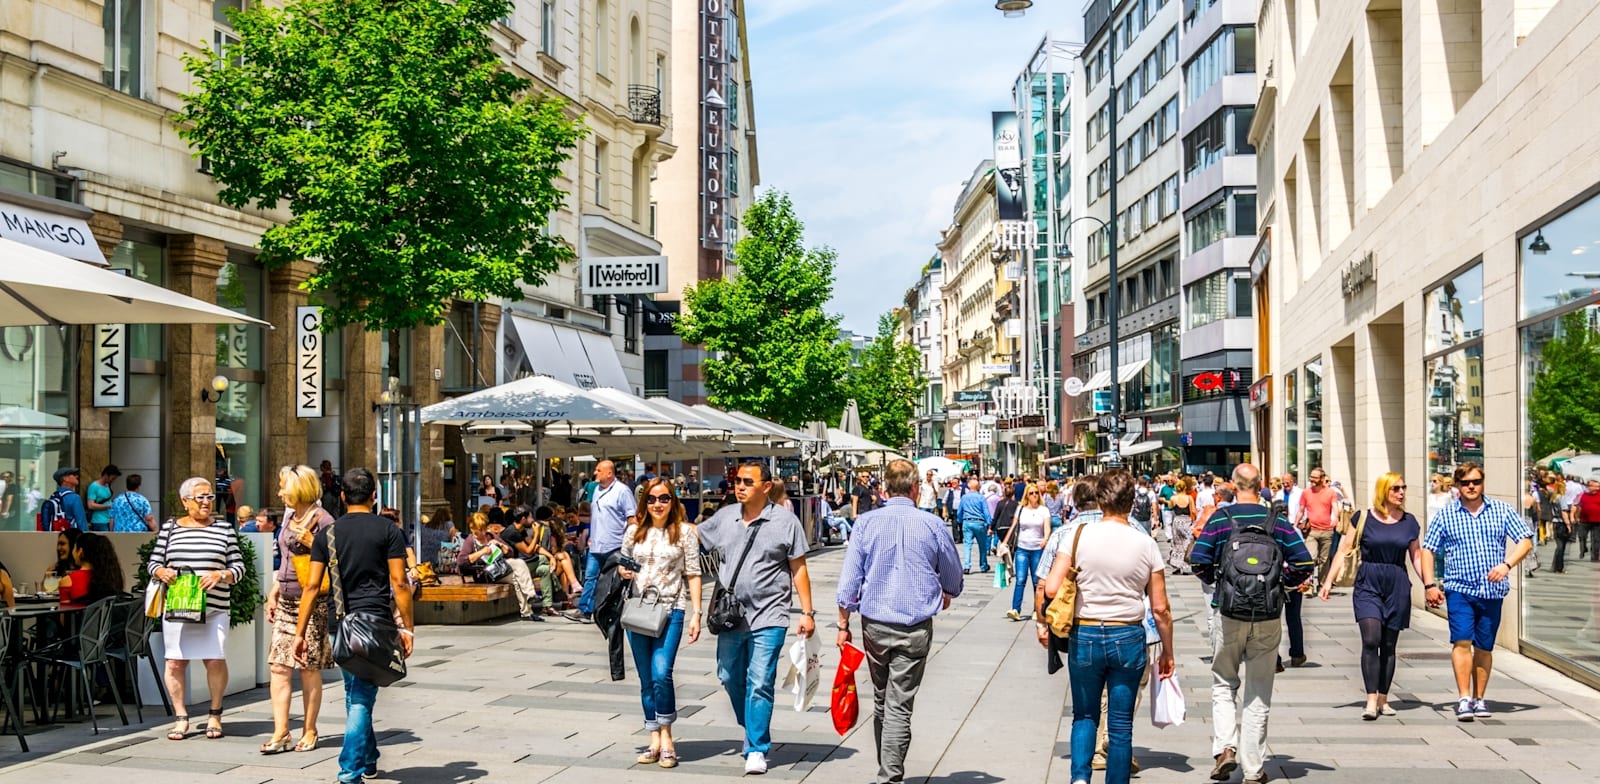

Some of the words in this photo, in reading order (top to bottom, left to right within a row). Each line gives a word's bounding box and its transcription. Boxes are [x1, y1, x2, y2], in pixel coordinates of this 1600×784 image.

[707, 0, 720, 81] OTEL
[707, 110, 720, 239] EUROPA
[1, 211, 86, 246] MANGO
[600, 268, 648, 282] Wolford
[658, 311, 677, 321] OSS
[100, 324, 120, 397] MAN
[301, 312, 319, 409] MANGO
[450, 410, 570, 418] Ambassador
